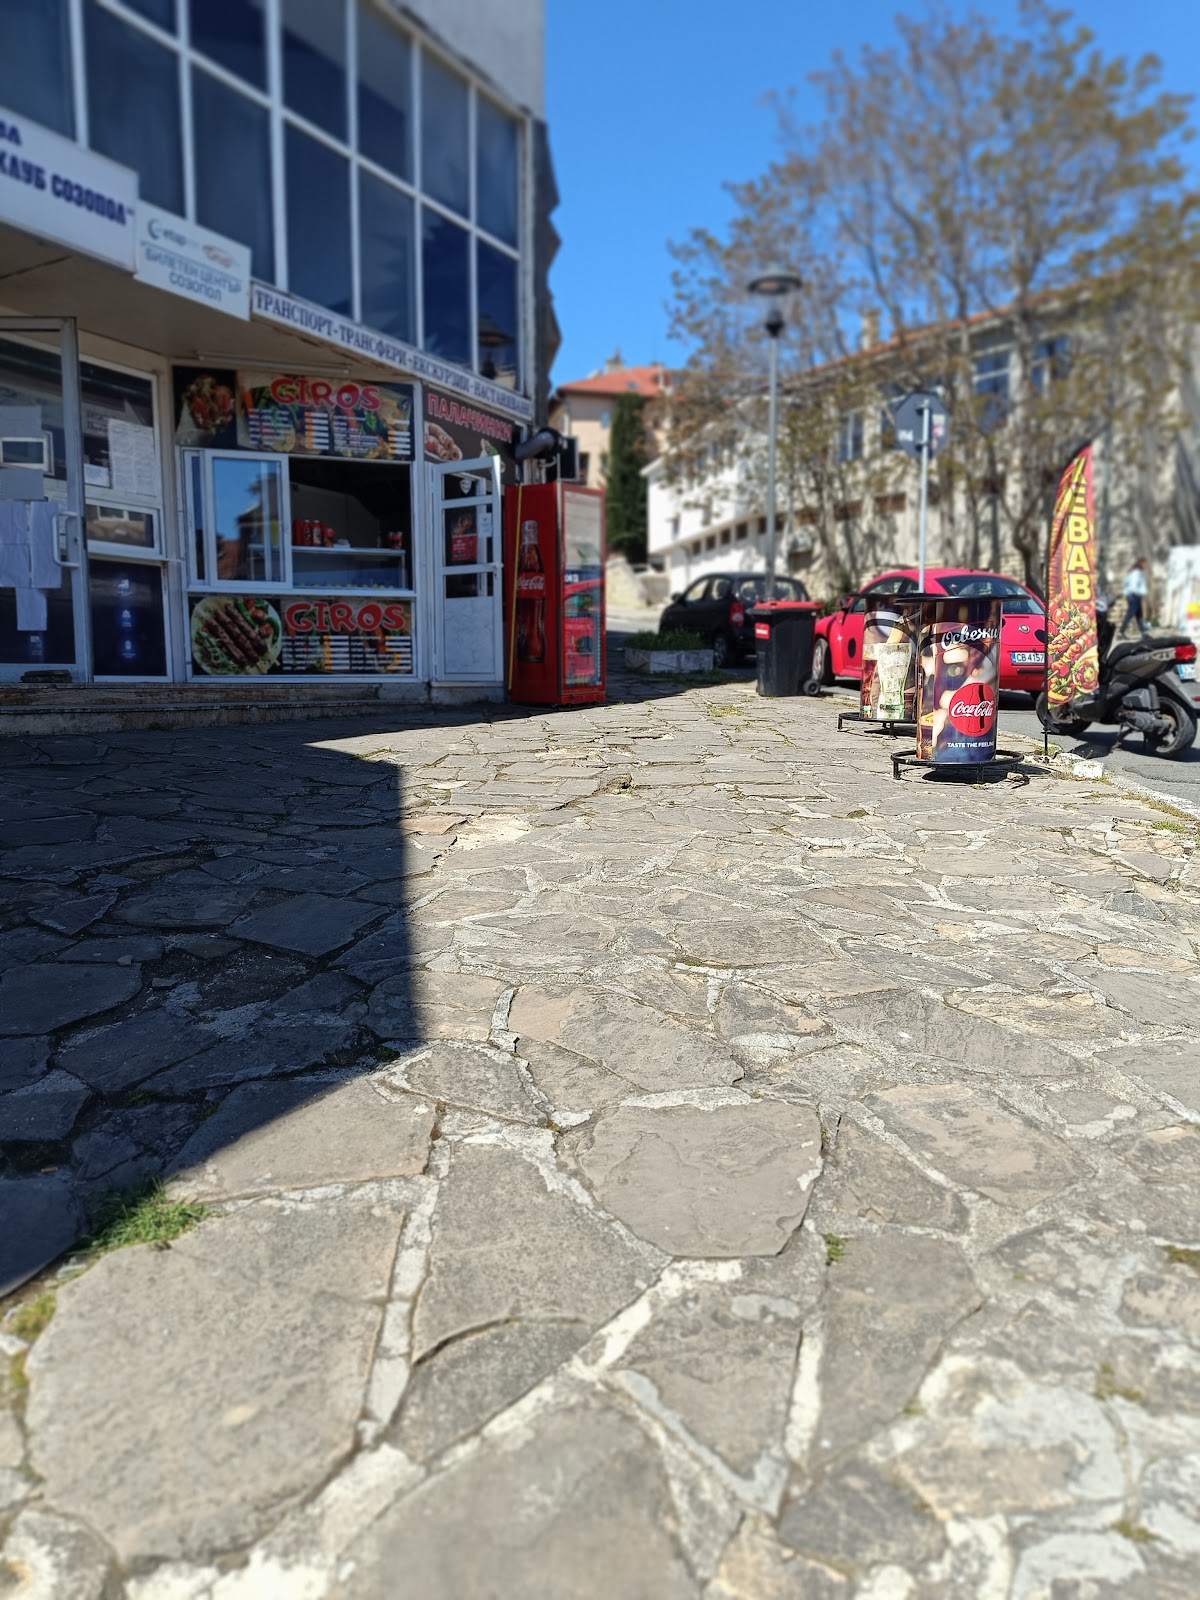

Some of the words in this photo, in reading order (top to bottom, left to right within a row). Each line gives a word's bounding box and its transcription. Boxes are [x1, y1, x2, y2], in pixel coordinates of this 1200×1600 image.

[169, 271, 222, 302] СОЗОПОЛ
[270, 376, 381, 411] GIROS
[428, 393, 513, 445] ПАЛАЧИНКИ
[284, 601, 405, 632] GIROS
[941, 625, 1001, 651] Освежи
[951, 700, 994, 717] Coca-Cola
